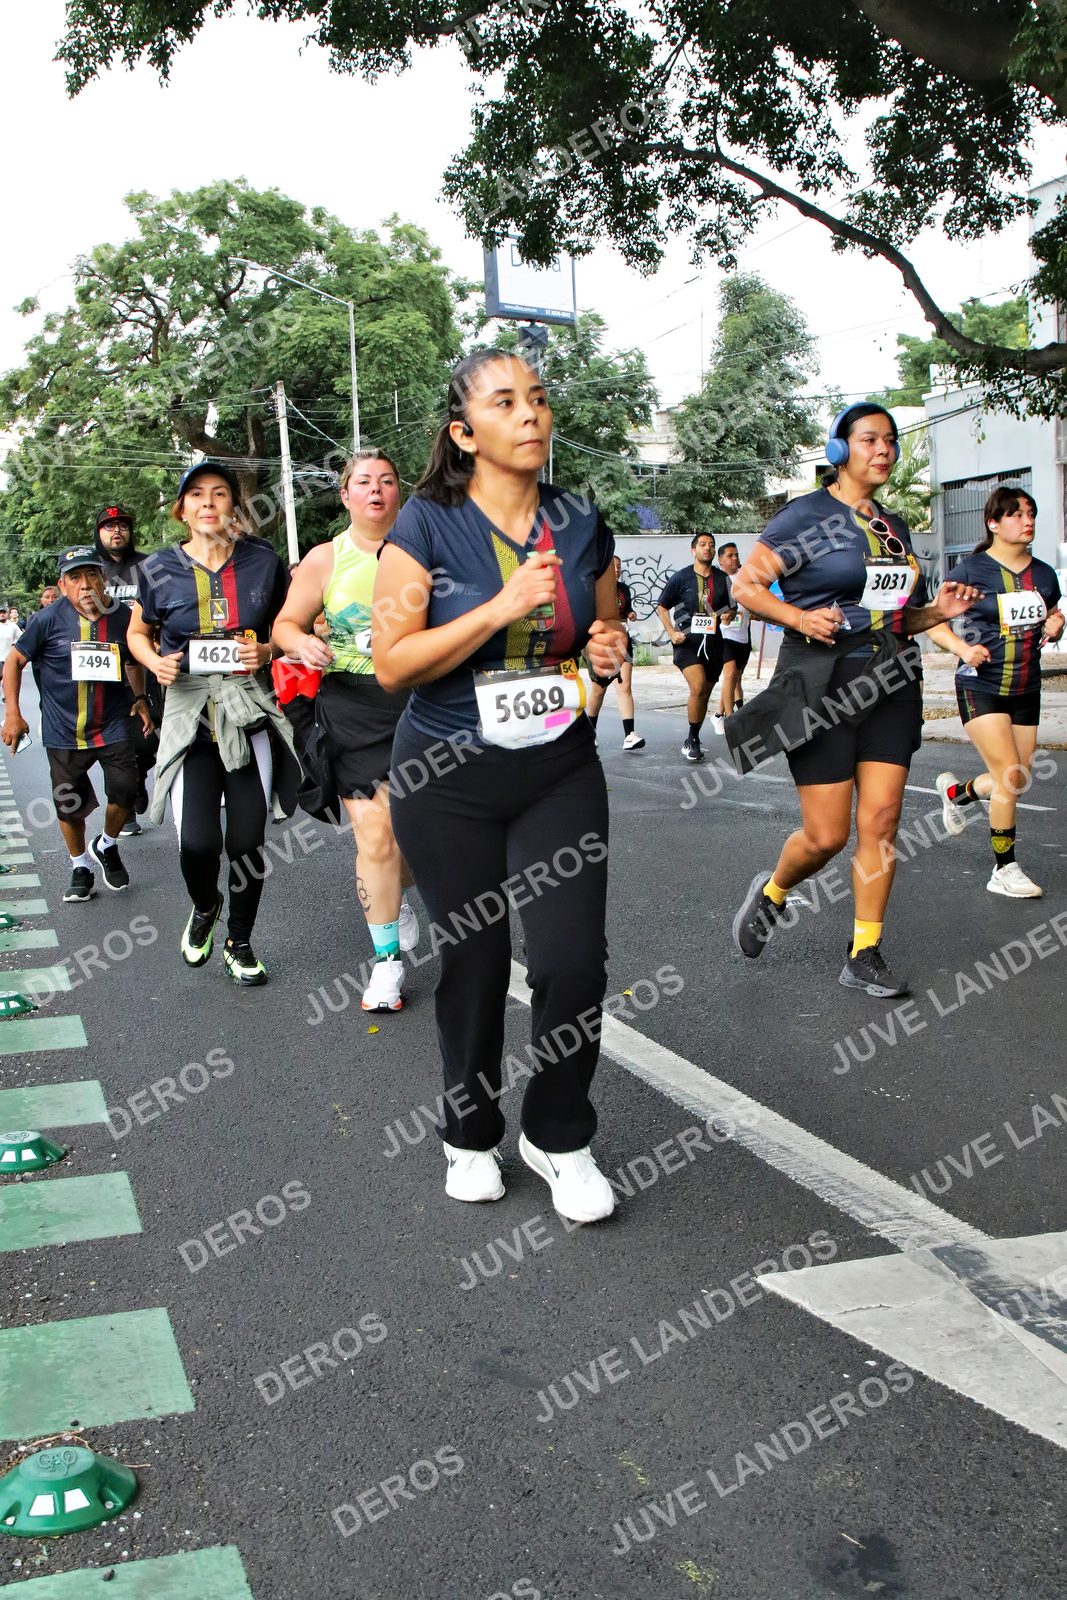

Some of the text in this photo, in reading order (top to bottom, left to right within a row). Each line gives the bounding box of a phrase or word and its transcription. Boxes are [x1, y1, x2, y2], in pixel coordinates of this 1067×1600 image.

[871, 573, 907, 591] 3031
[1010, 604, 1043, 621] 3374
[695, 618, 712, 627] 2259
[78, 655, 111, 669] 2494
[495, 686, 565, 723] 5689
